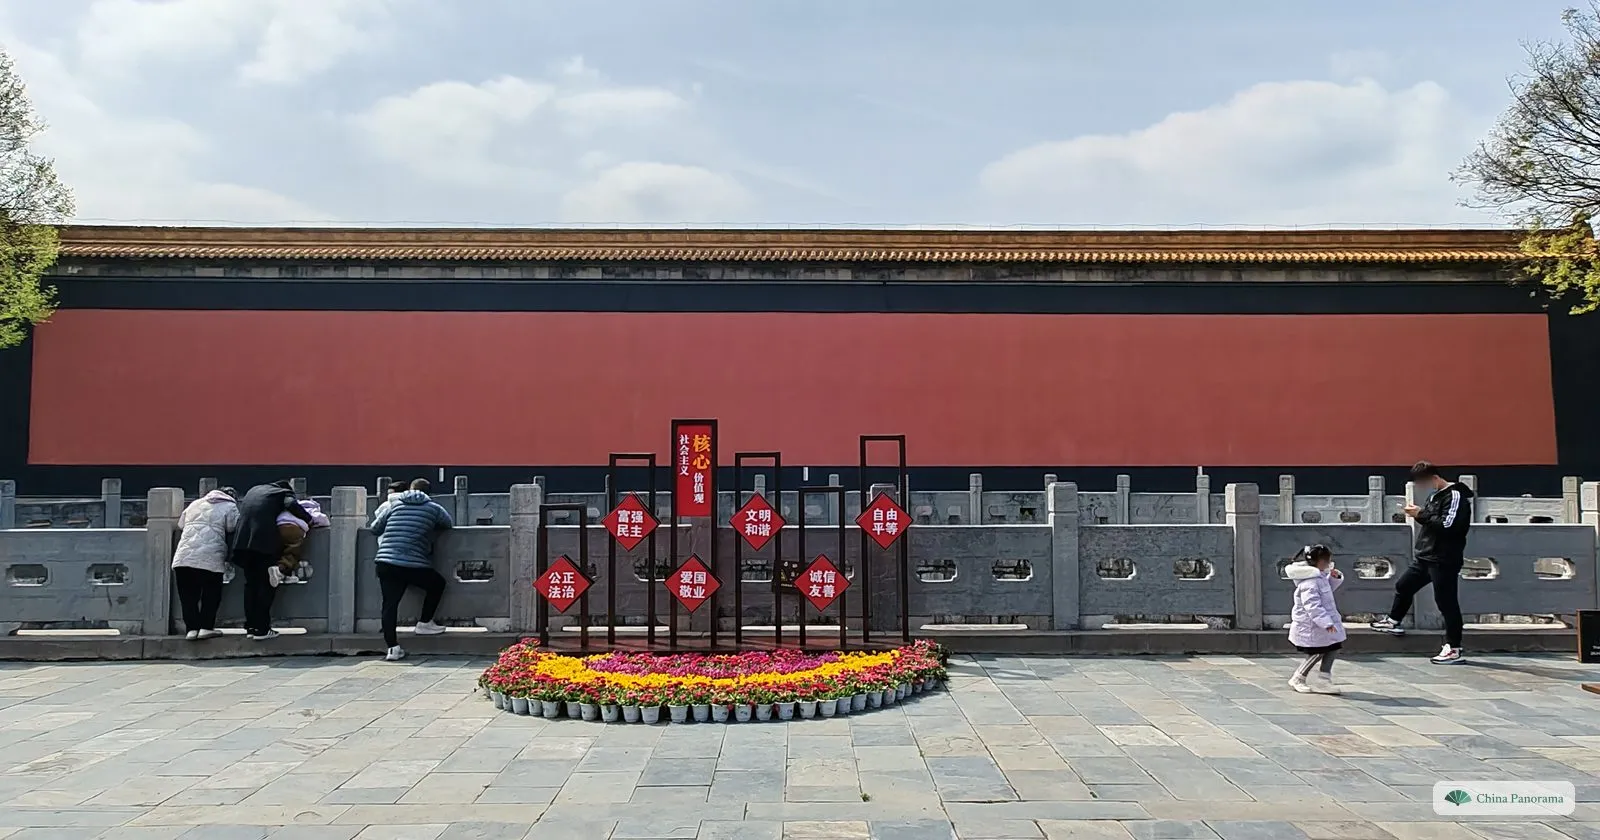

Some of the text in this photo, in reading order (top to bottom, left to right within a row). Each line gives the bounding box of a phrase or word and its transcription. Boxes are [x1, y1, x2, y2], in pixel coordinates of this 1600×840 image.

[680, 434, 690, 476] 社会主义
[617, 509, 644, 524] 富强
[745, 509, 771, 522] 文明
[873, 507, 898, 522] 自由
[617, 523, 643, 538] 民主
[745, 523, 771, 537] 和谐
[872, 521, 898, 536] 平等
[548, 571, 575, 584] 公正
[680, 570, 707, 585] 爱国
[809, 570, 836, 584] 诚信
[548, 585, 575, 599] 法治
[679, 584, 706, 599] 敬业
[809, 584, 836, 598] 友善
